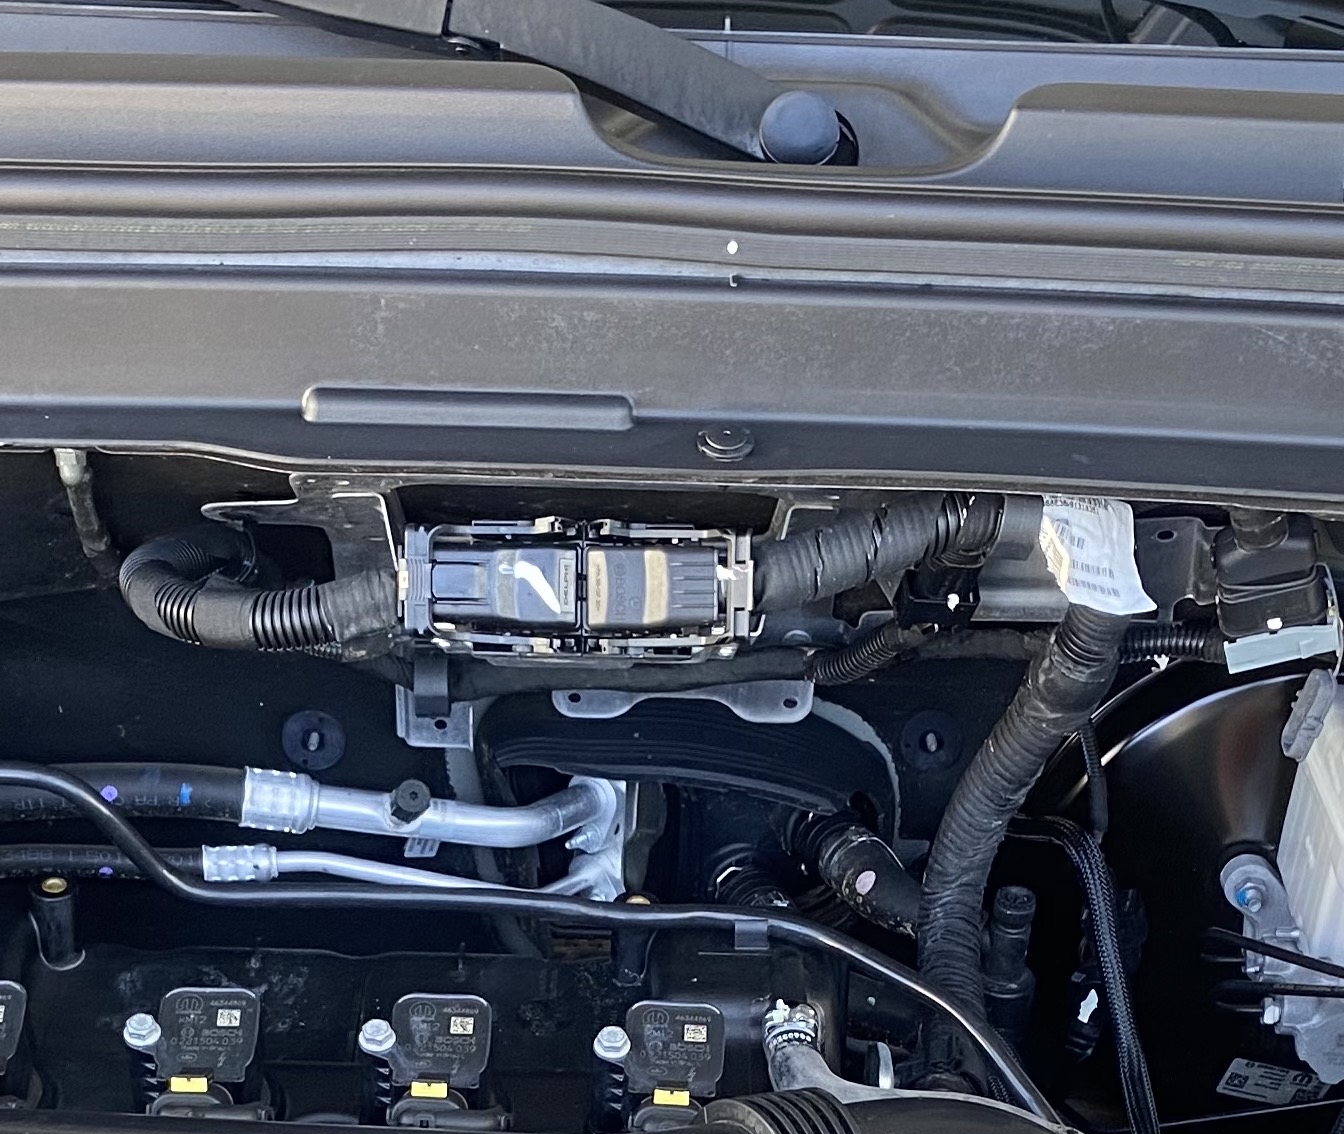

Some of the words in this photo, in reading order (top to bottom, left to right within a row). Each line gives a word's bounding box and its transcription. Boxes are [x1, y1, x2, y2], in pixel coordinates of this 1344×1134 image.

[563, 563, 571, 606] DELPHI
[201, 1028, 243, 1038] BOSCH
[435, 1036, 476, 1045] BOSCH
[669, 1042, 710, 1052] BOSCH
